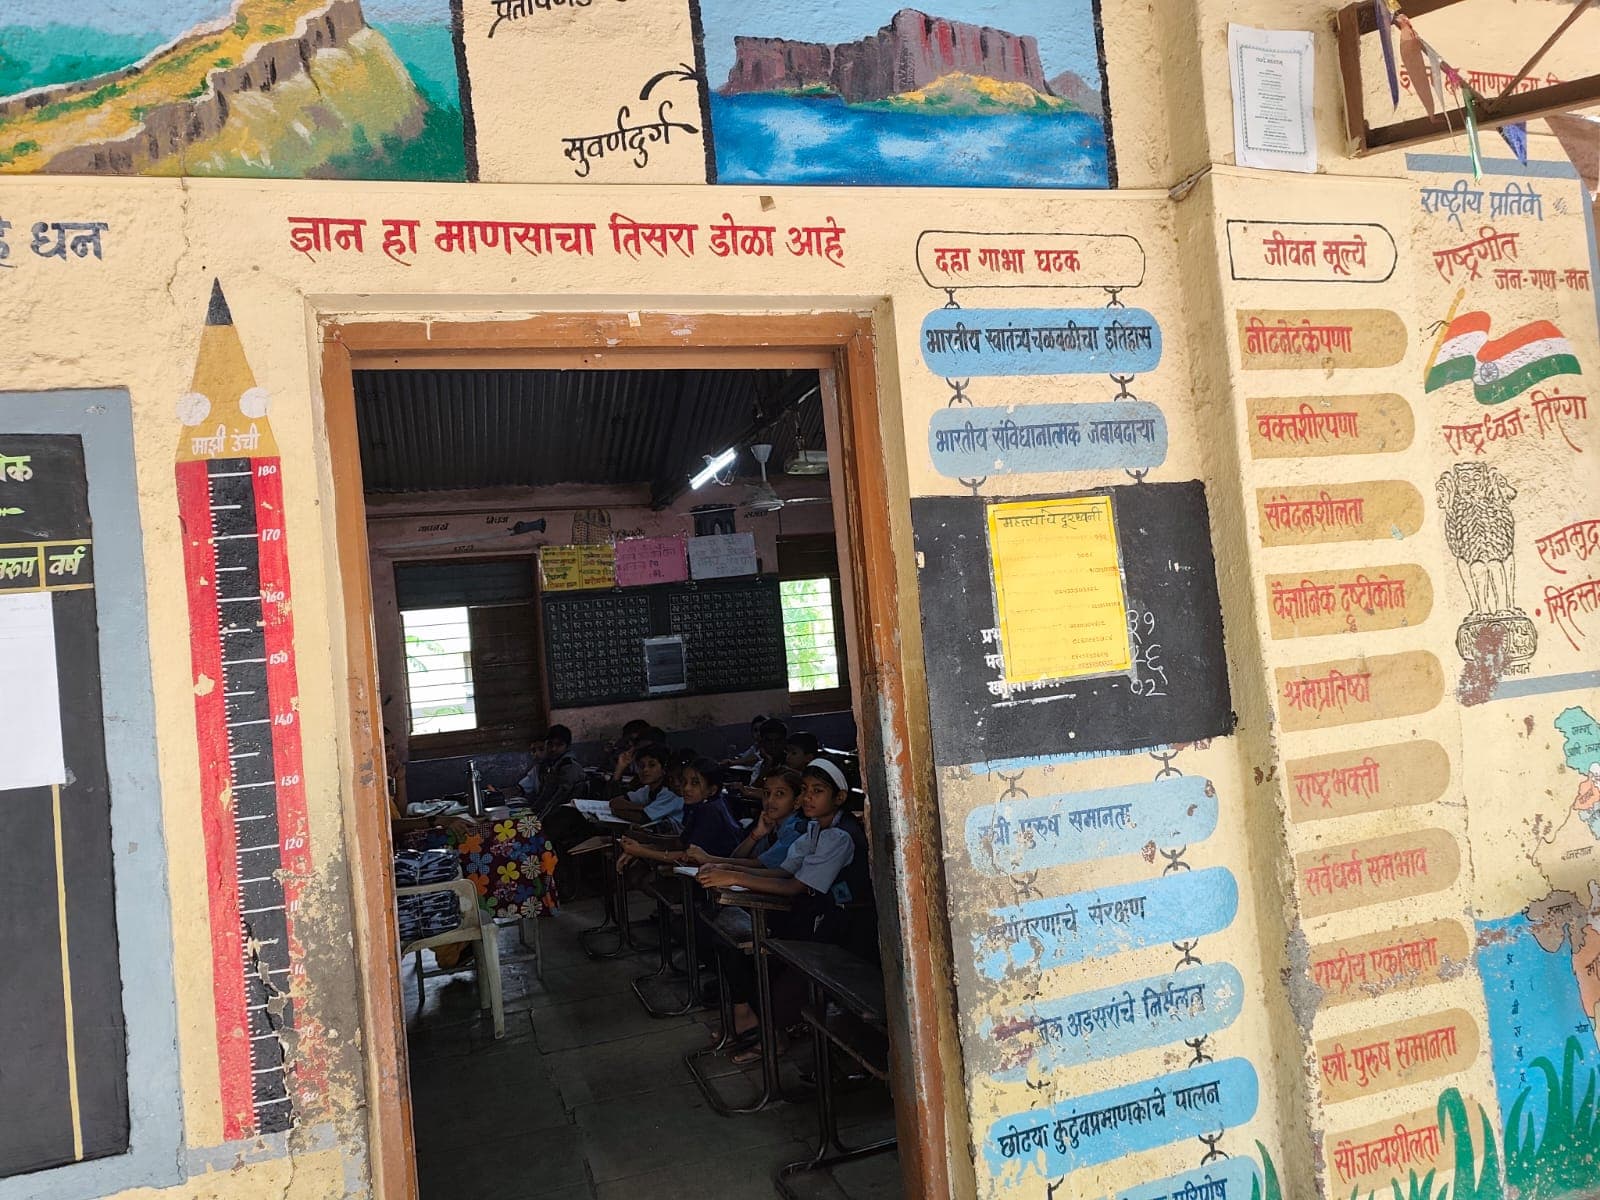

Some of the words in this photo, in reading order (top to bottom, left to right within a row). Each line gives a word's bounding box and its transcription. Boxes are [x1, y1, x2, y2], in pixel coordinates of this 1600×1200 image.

[561, 100, 699, 177] सुवर्णदुर्ग
[1420, 180, 1484, 232] राष्ट्रीय
[31, 221, 109, 261] धन
[288, 217, 366, 263] ज्ञान
[382, 220, 420, 266] हा
[435, 220, 596, 256] माणसाचा
[608, 213, 698, 259] तिसरा
[709, 213, 776, 258] डोळा
[785, 216, 846, 268] आहे
[1263, 230, 1317, 267] जीवन
[1323, 234, 1367, 276] मूल्ये
[1433, 226, 1519, 284] राष्ट्रगीत
[935, 248, 970, 277] दहा
[979, 249, 1025, 273] गाभा
[1034, 250, 1081, 273] घटक
[926, 322, 981, 353] भारतीय
[1104, 320, 1152, 353] इतिहास
[191, 423, 226, 459] माझी
[230, 422, 261, 452] उंची
[936, 421, 988, 453] भारतीय
[258, 465, 277, 477] 180
[1263, 490, 1365, 534] संवेदनशीलता
[262, 530, 280, 541] 170
[49, 546, 86, 575] वर्ष
[1272, 579, 1336, 624] वैज्ञानिक
[274, 713, 294, 726] 140
[285, 838, 304, 851] 120
[1395, 1026, 1457, 1070] समानता
[1172, 1079, 1221, 1112] पालन
